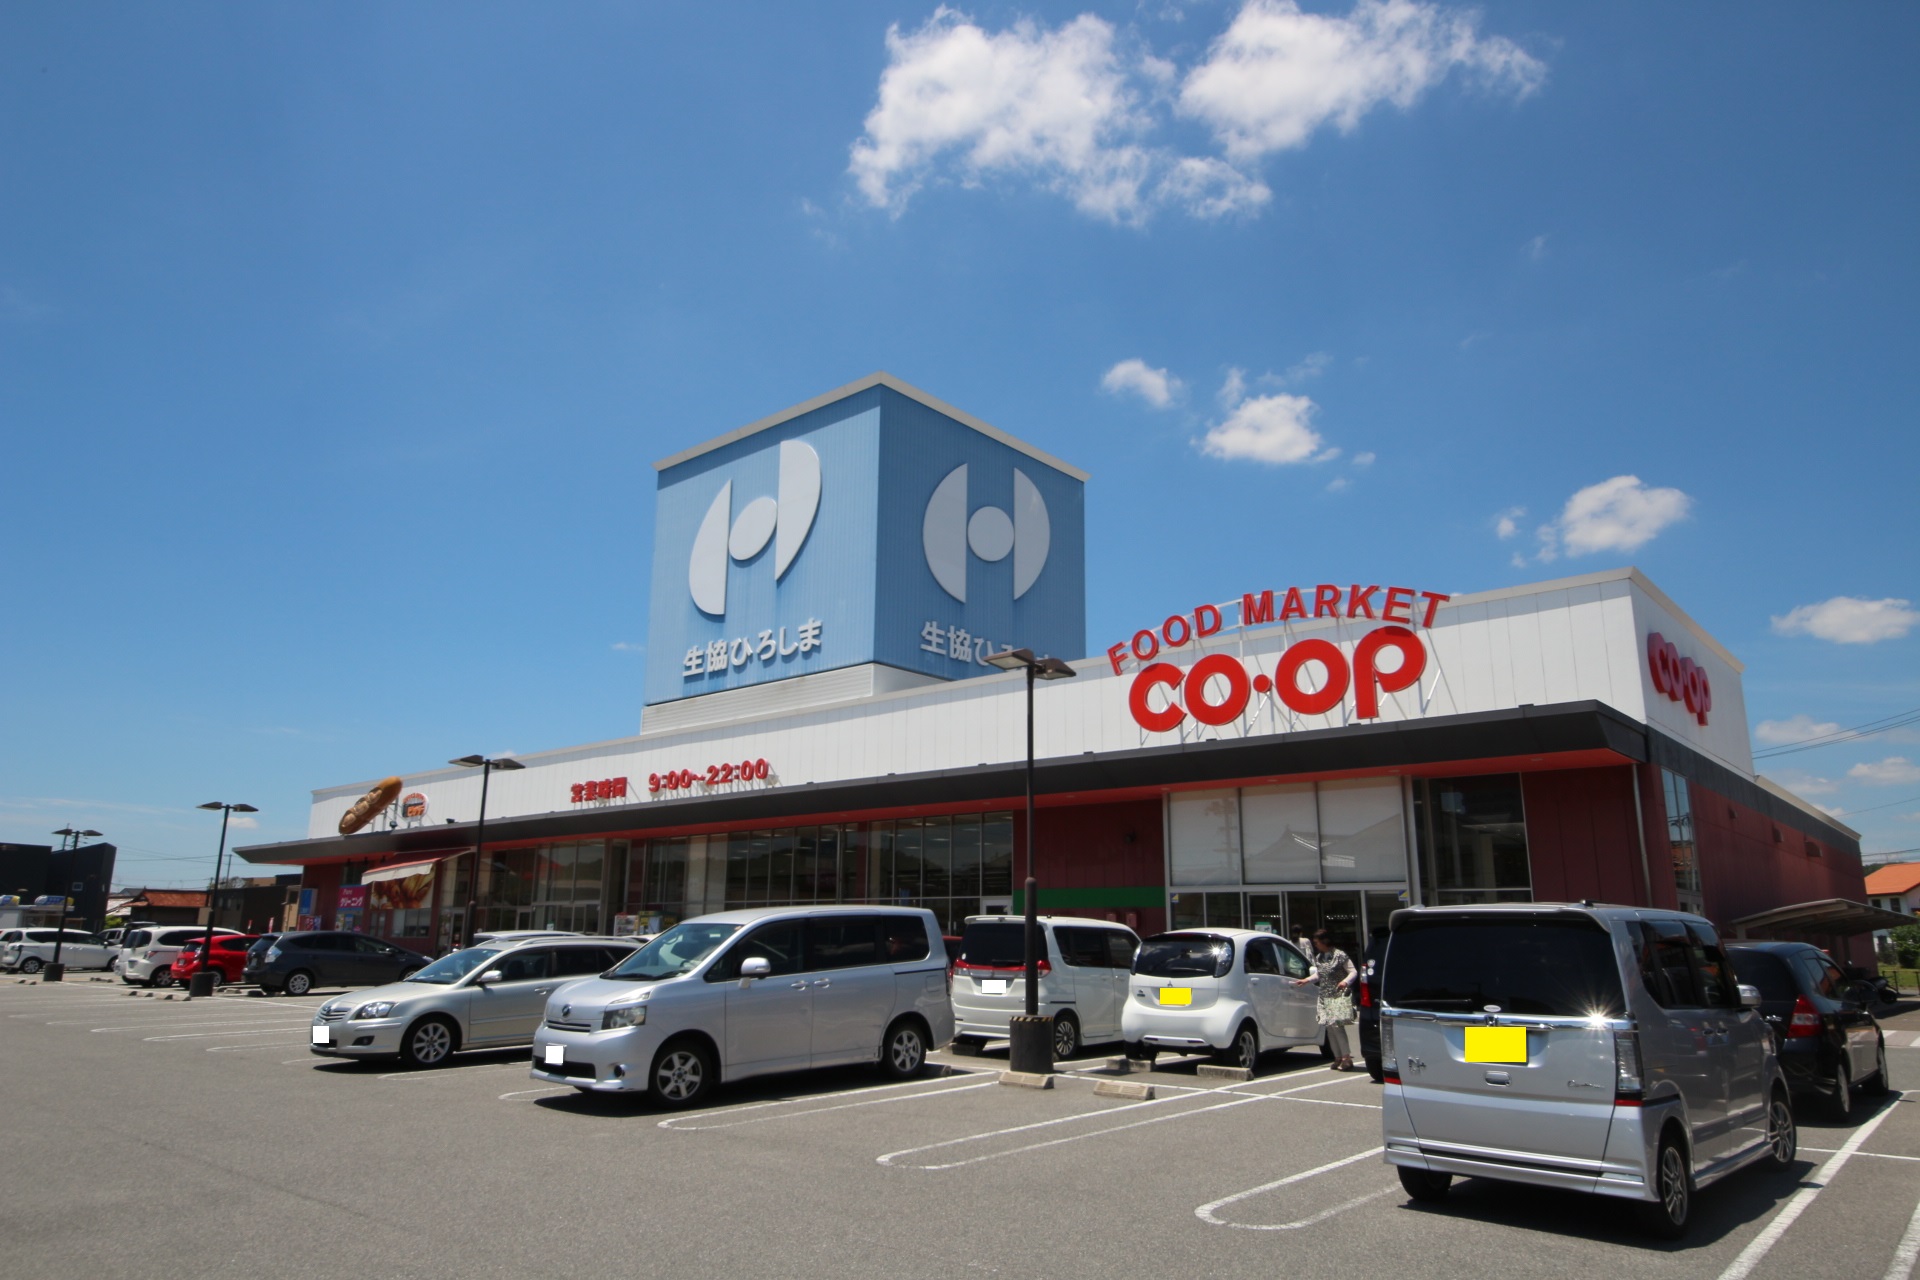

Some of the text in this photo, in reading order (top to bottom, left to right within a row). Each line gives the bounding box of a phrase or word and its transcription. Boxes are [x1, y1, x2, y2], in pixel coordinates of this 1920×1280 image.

[682, 617, 823, 677] 生協ひろしま
[1107, 584, 1450, 676] FOOD MARKET
[571, 777, 628, 803] 営業時間
